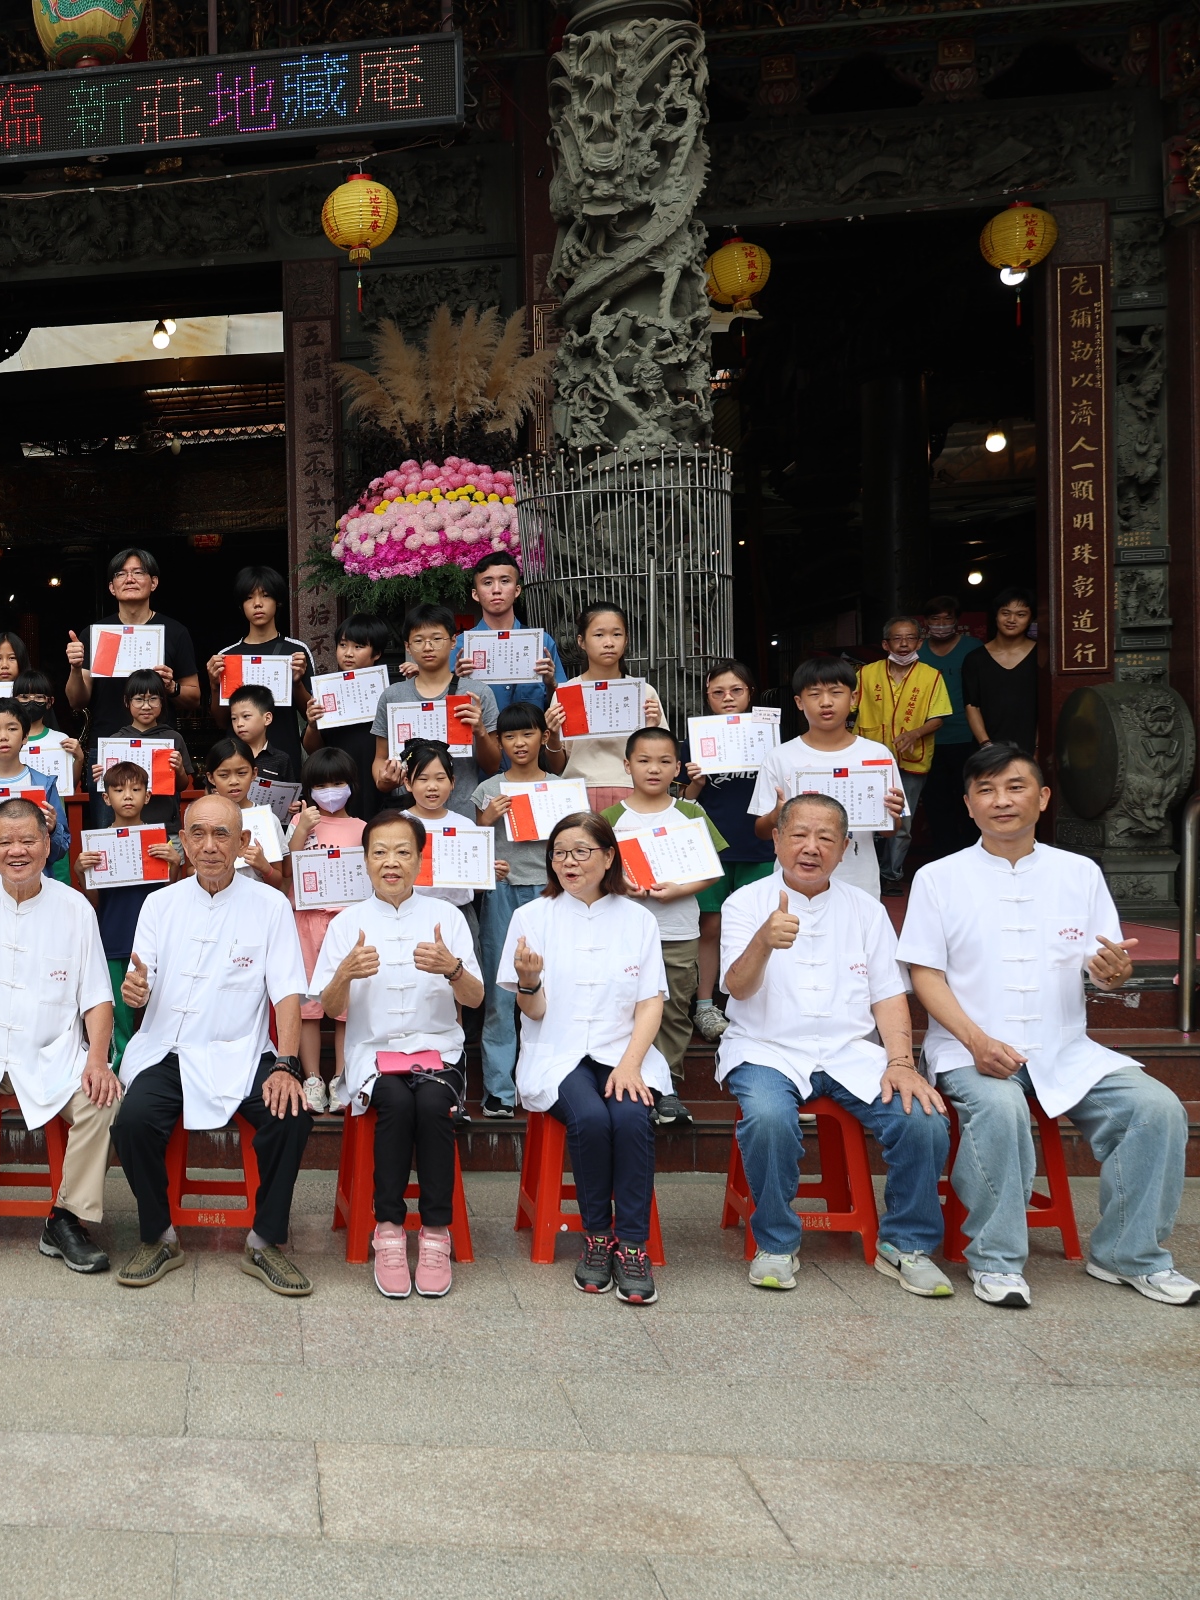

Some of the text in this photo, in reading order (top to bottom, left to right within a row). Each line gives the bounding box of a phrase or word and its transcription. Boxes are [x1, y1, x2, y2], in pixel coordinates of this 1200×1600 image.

[67, 45, 424, 146] 新莊地藏庵
